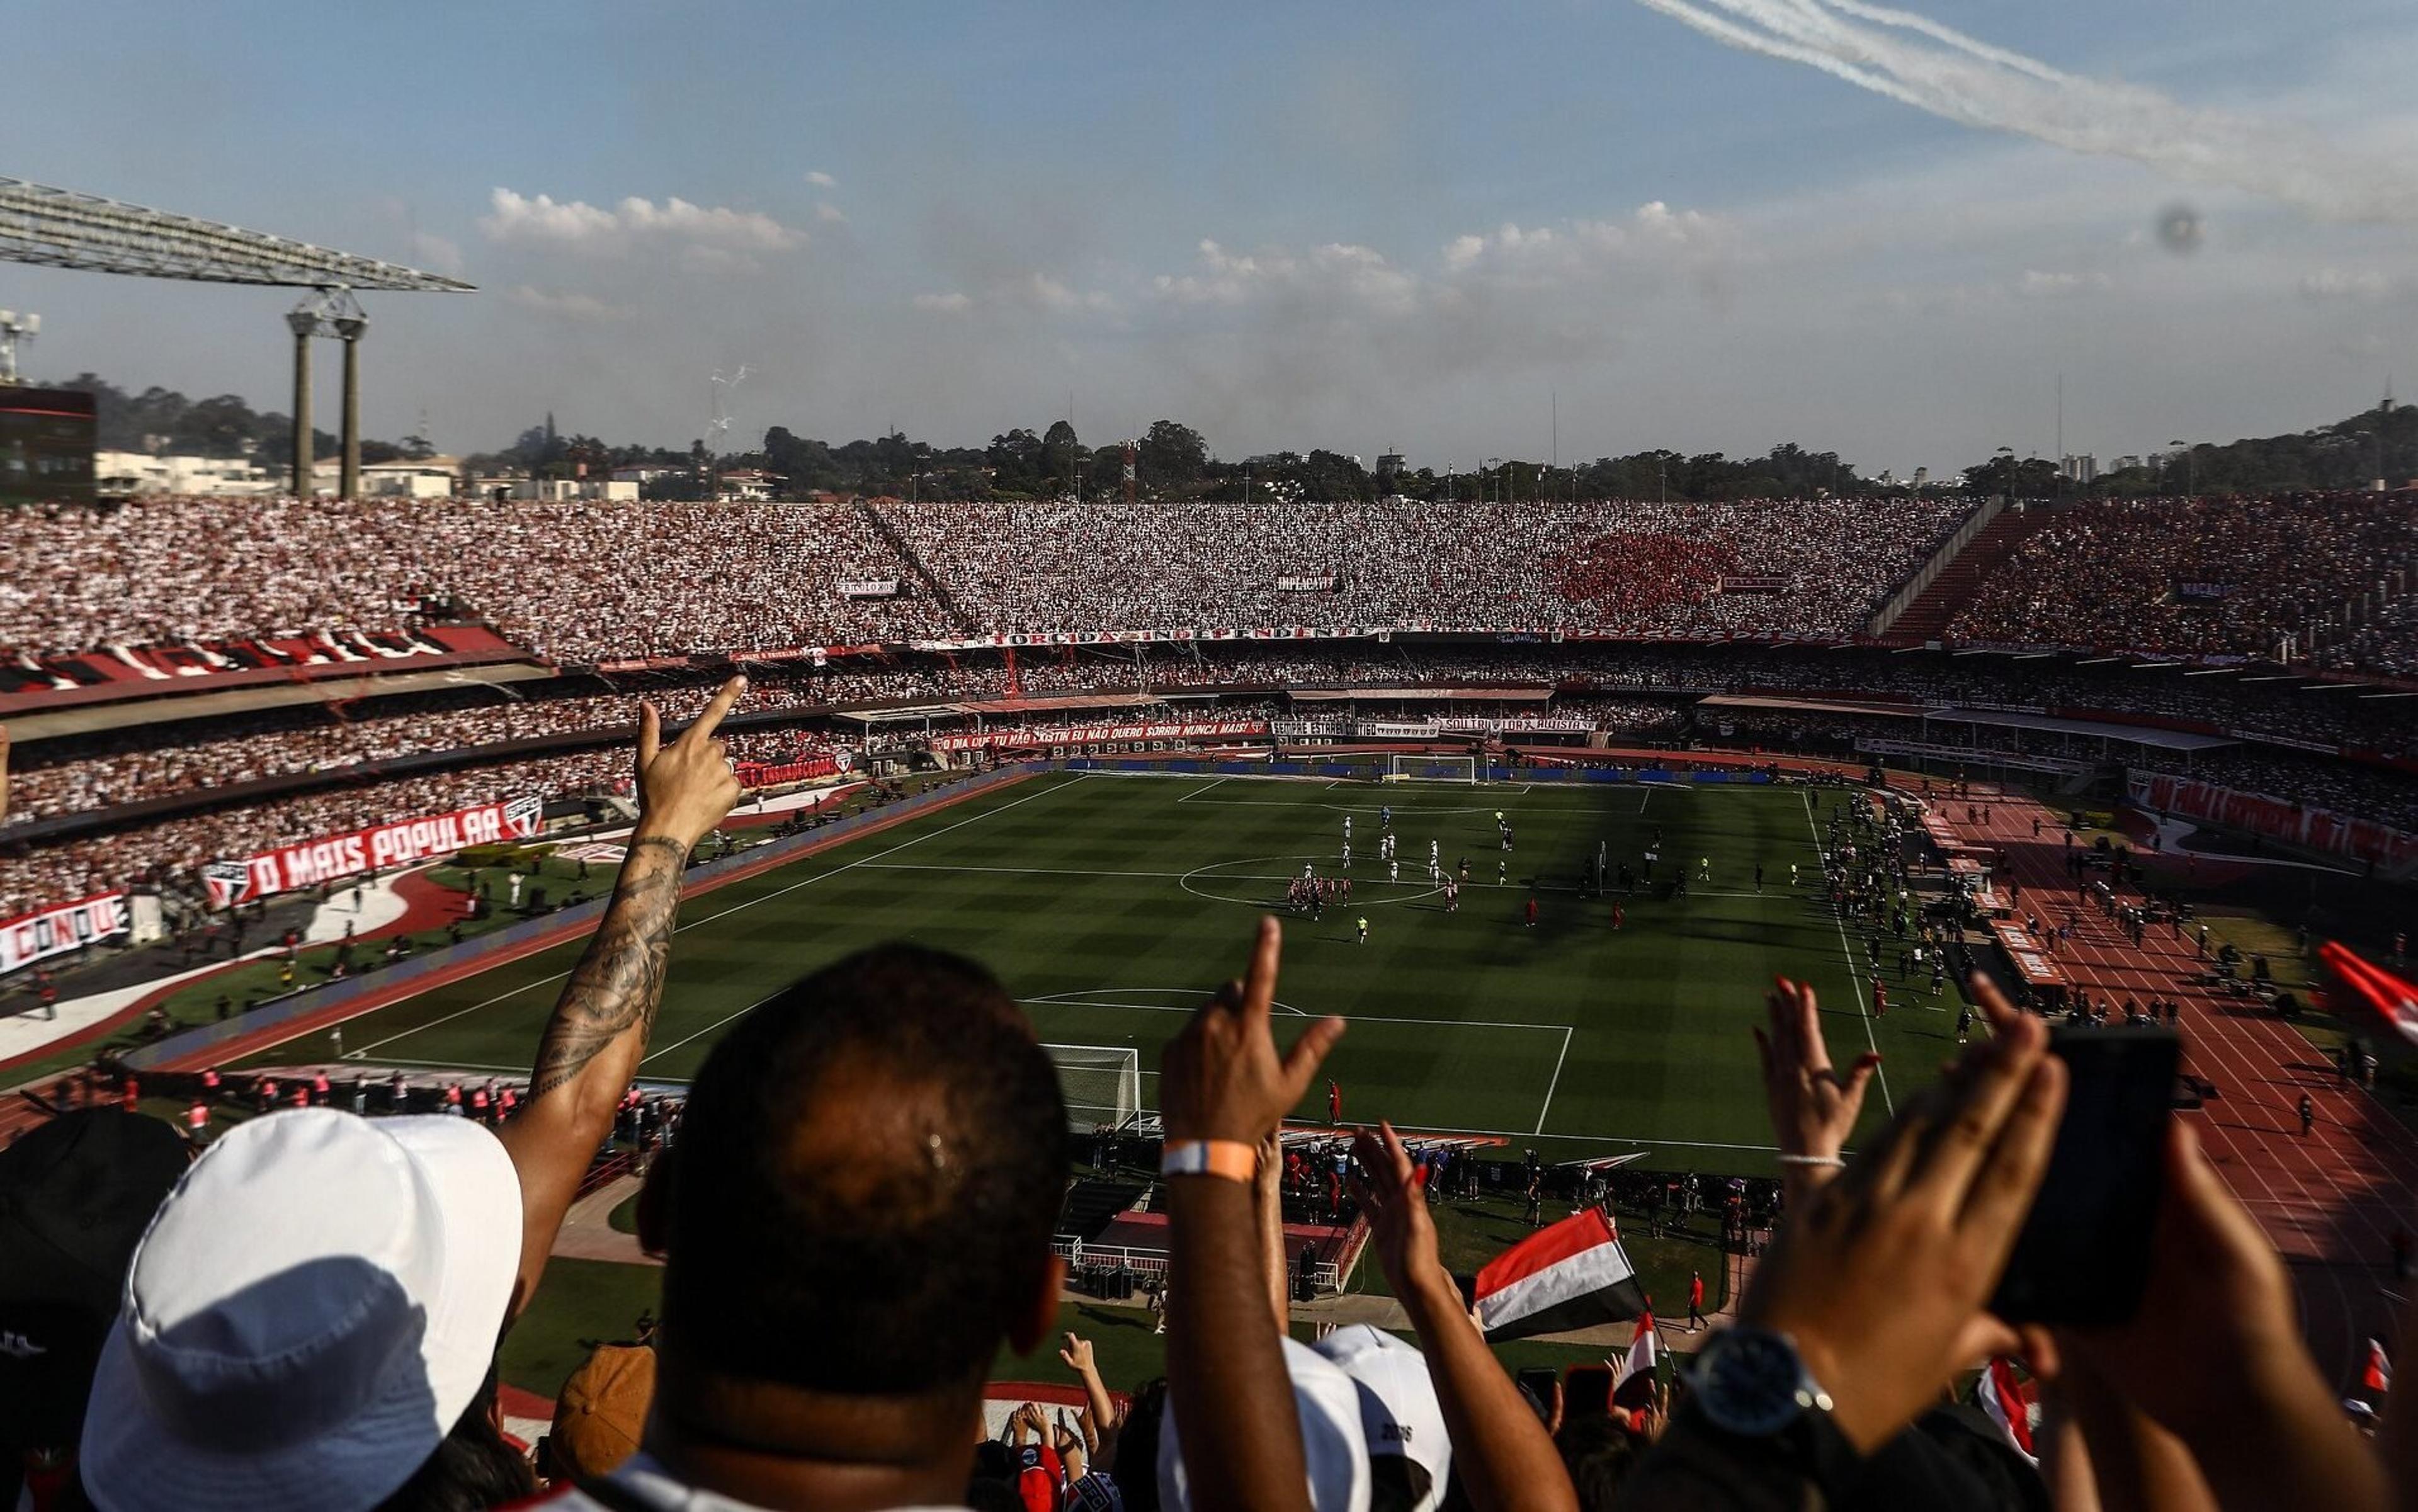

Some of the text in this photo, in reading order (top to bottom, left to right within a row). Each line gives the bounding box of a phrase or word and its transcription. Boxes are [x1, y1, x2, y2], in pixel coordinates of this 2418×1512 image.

[992, 631, 1118, 645] TORCIDA
[952, 737, 968, 749] DIA
[994, 736, 1006, 746] TU
[1010, 732, 1030, 744] NÃO
[1033, 730, 1070, 742] XISTIR
[1072, 729, 1084, 740] EU
[1087, 726, 1107, 739] NÃO
[1111, 726, 1142, 739] QUERO
[1146, 725, 1180, 737] SORRIR
[1183, 724, 1216, 735] NUNCA
[1220, 723, 1248, 734] MAIS!
[1274, 722, 1308, 735] SEMPRE
[1312, 722, 1342, 736] ESTARE
[254, 808, 502, 895] O MAIS POPULAR
